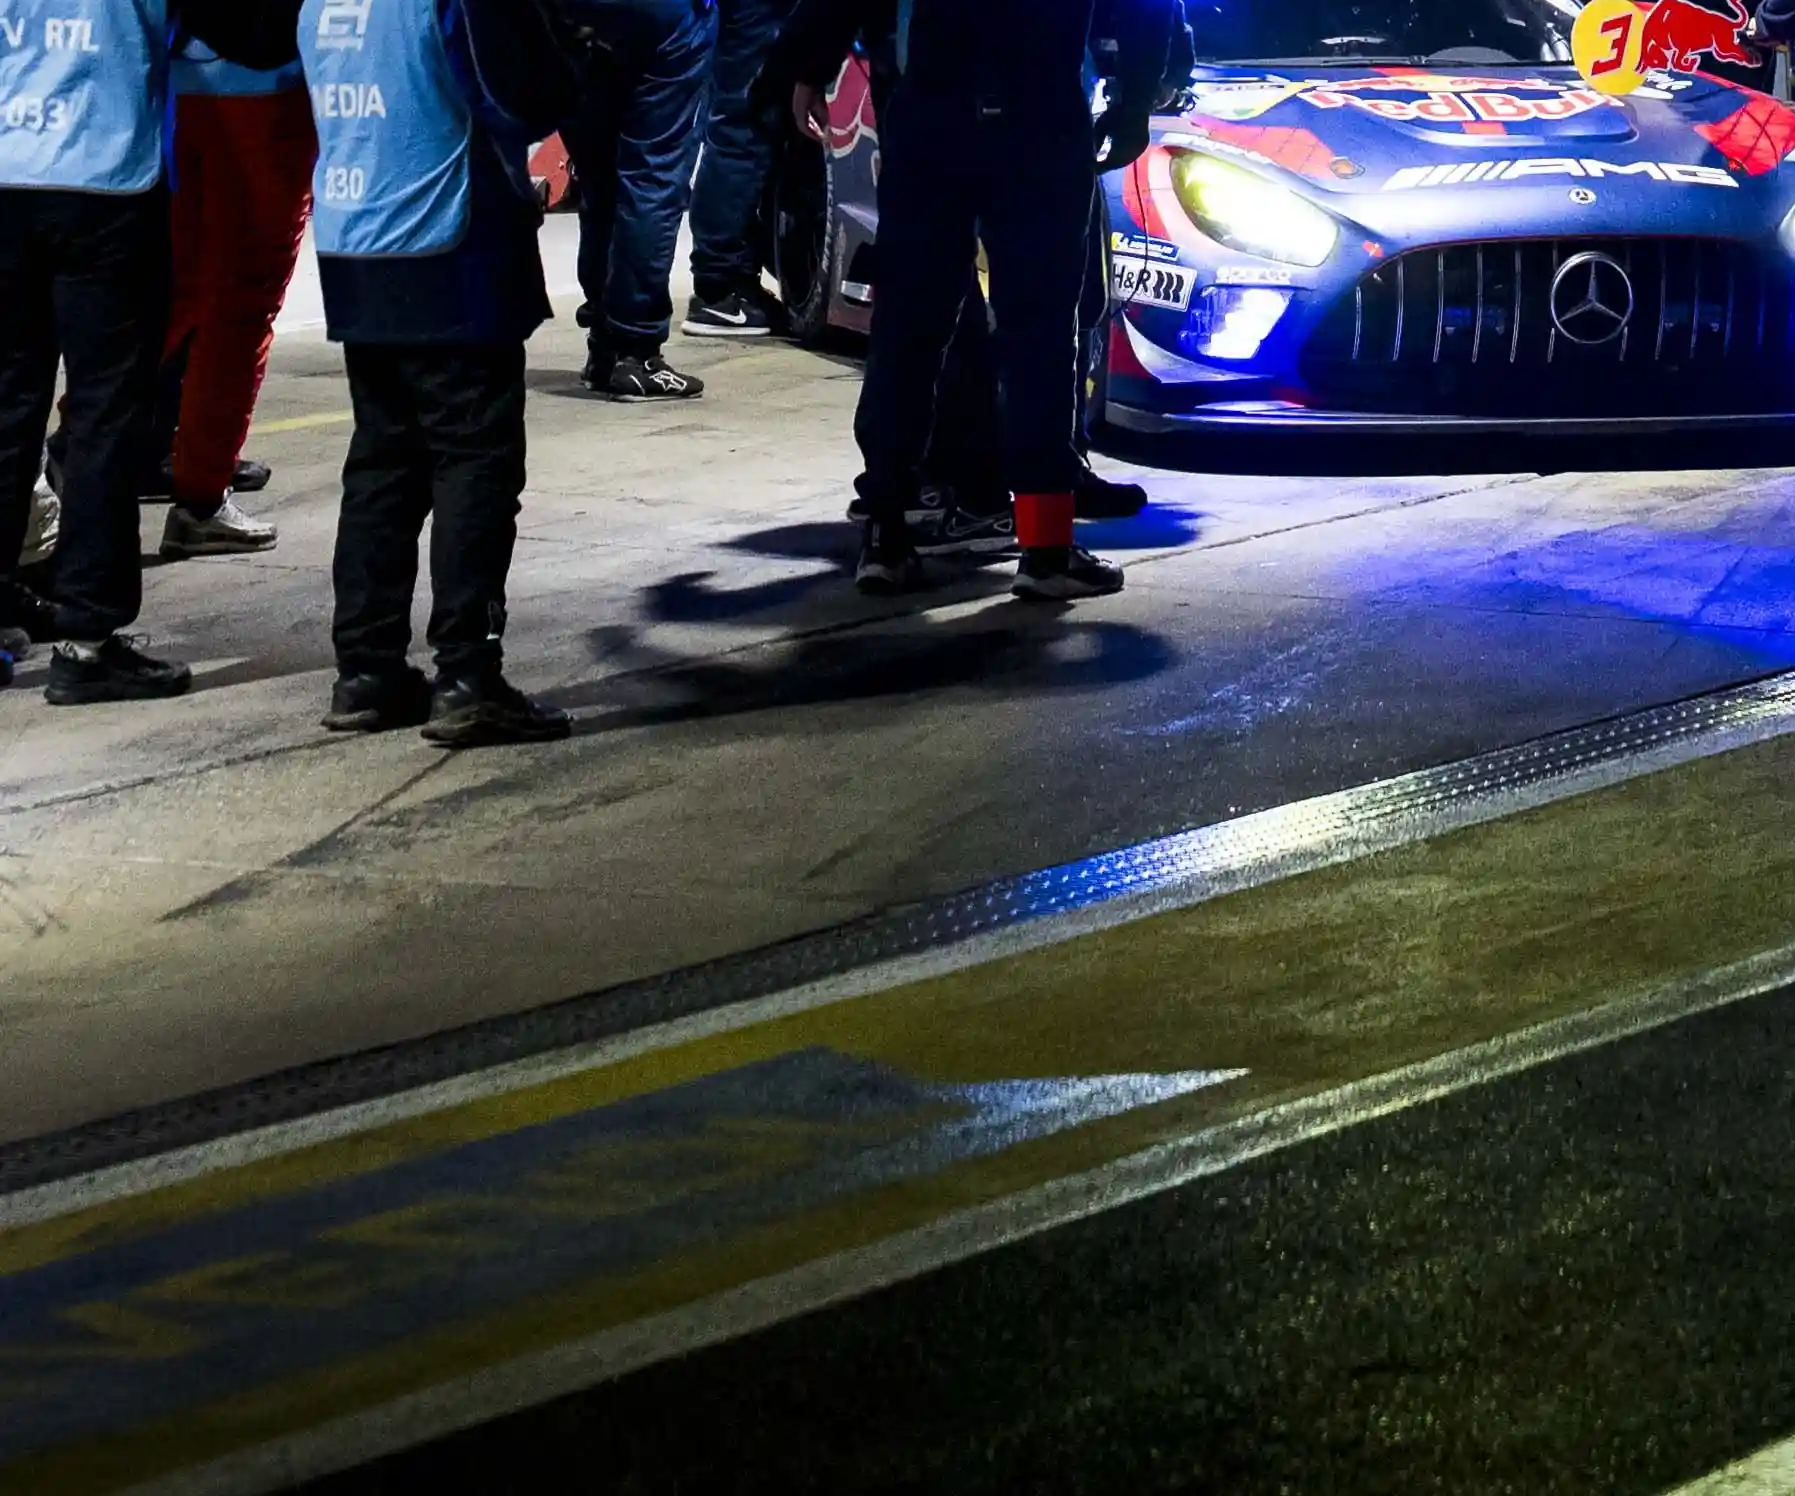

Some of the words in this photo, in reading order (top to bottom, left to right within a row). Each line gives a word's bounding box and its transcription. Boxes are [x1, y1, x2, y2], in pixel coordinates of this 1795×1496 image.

[45, 19, 100, 52] RTL
[1297, 89, 1455, 120] Red
[1504, 158, 1740, 188] AMG
[1113, 264, 1151, 293] H&R
